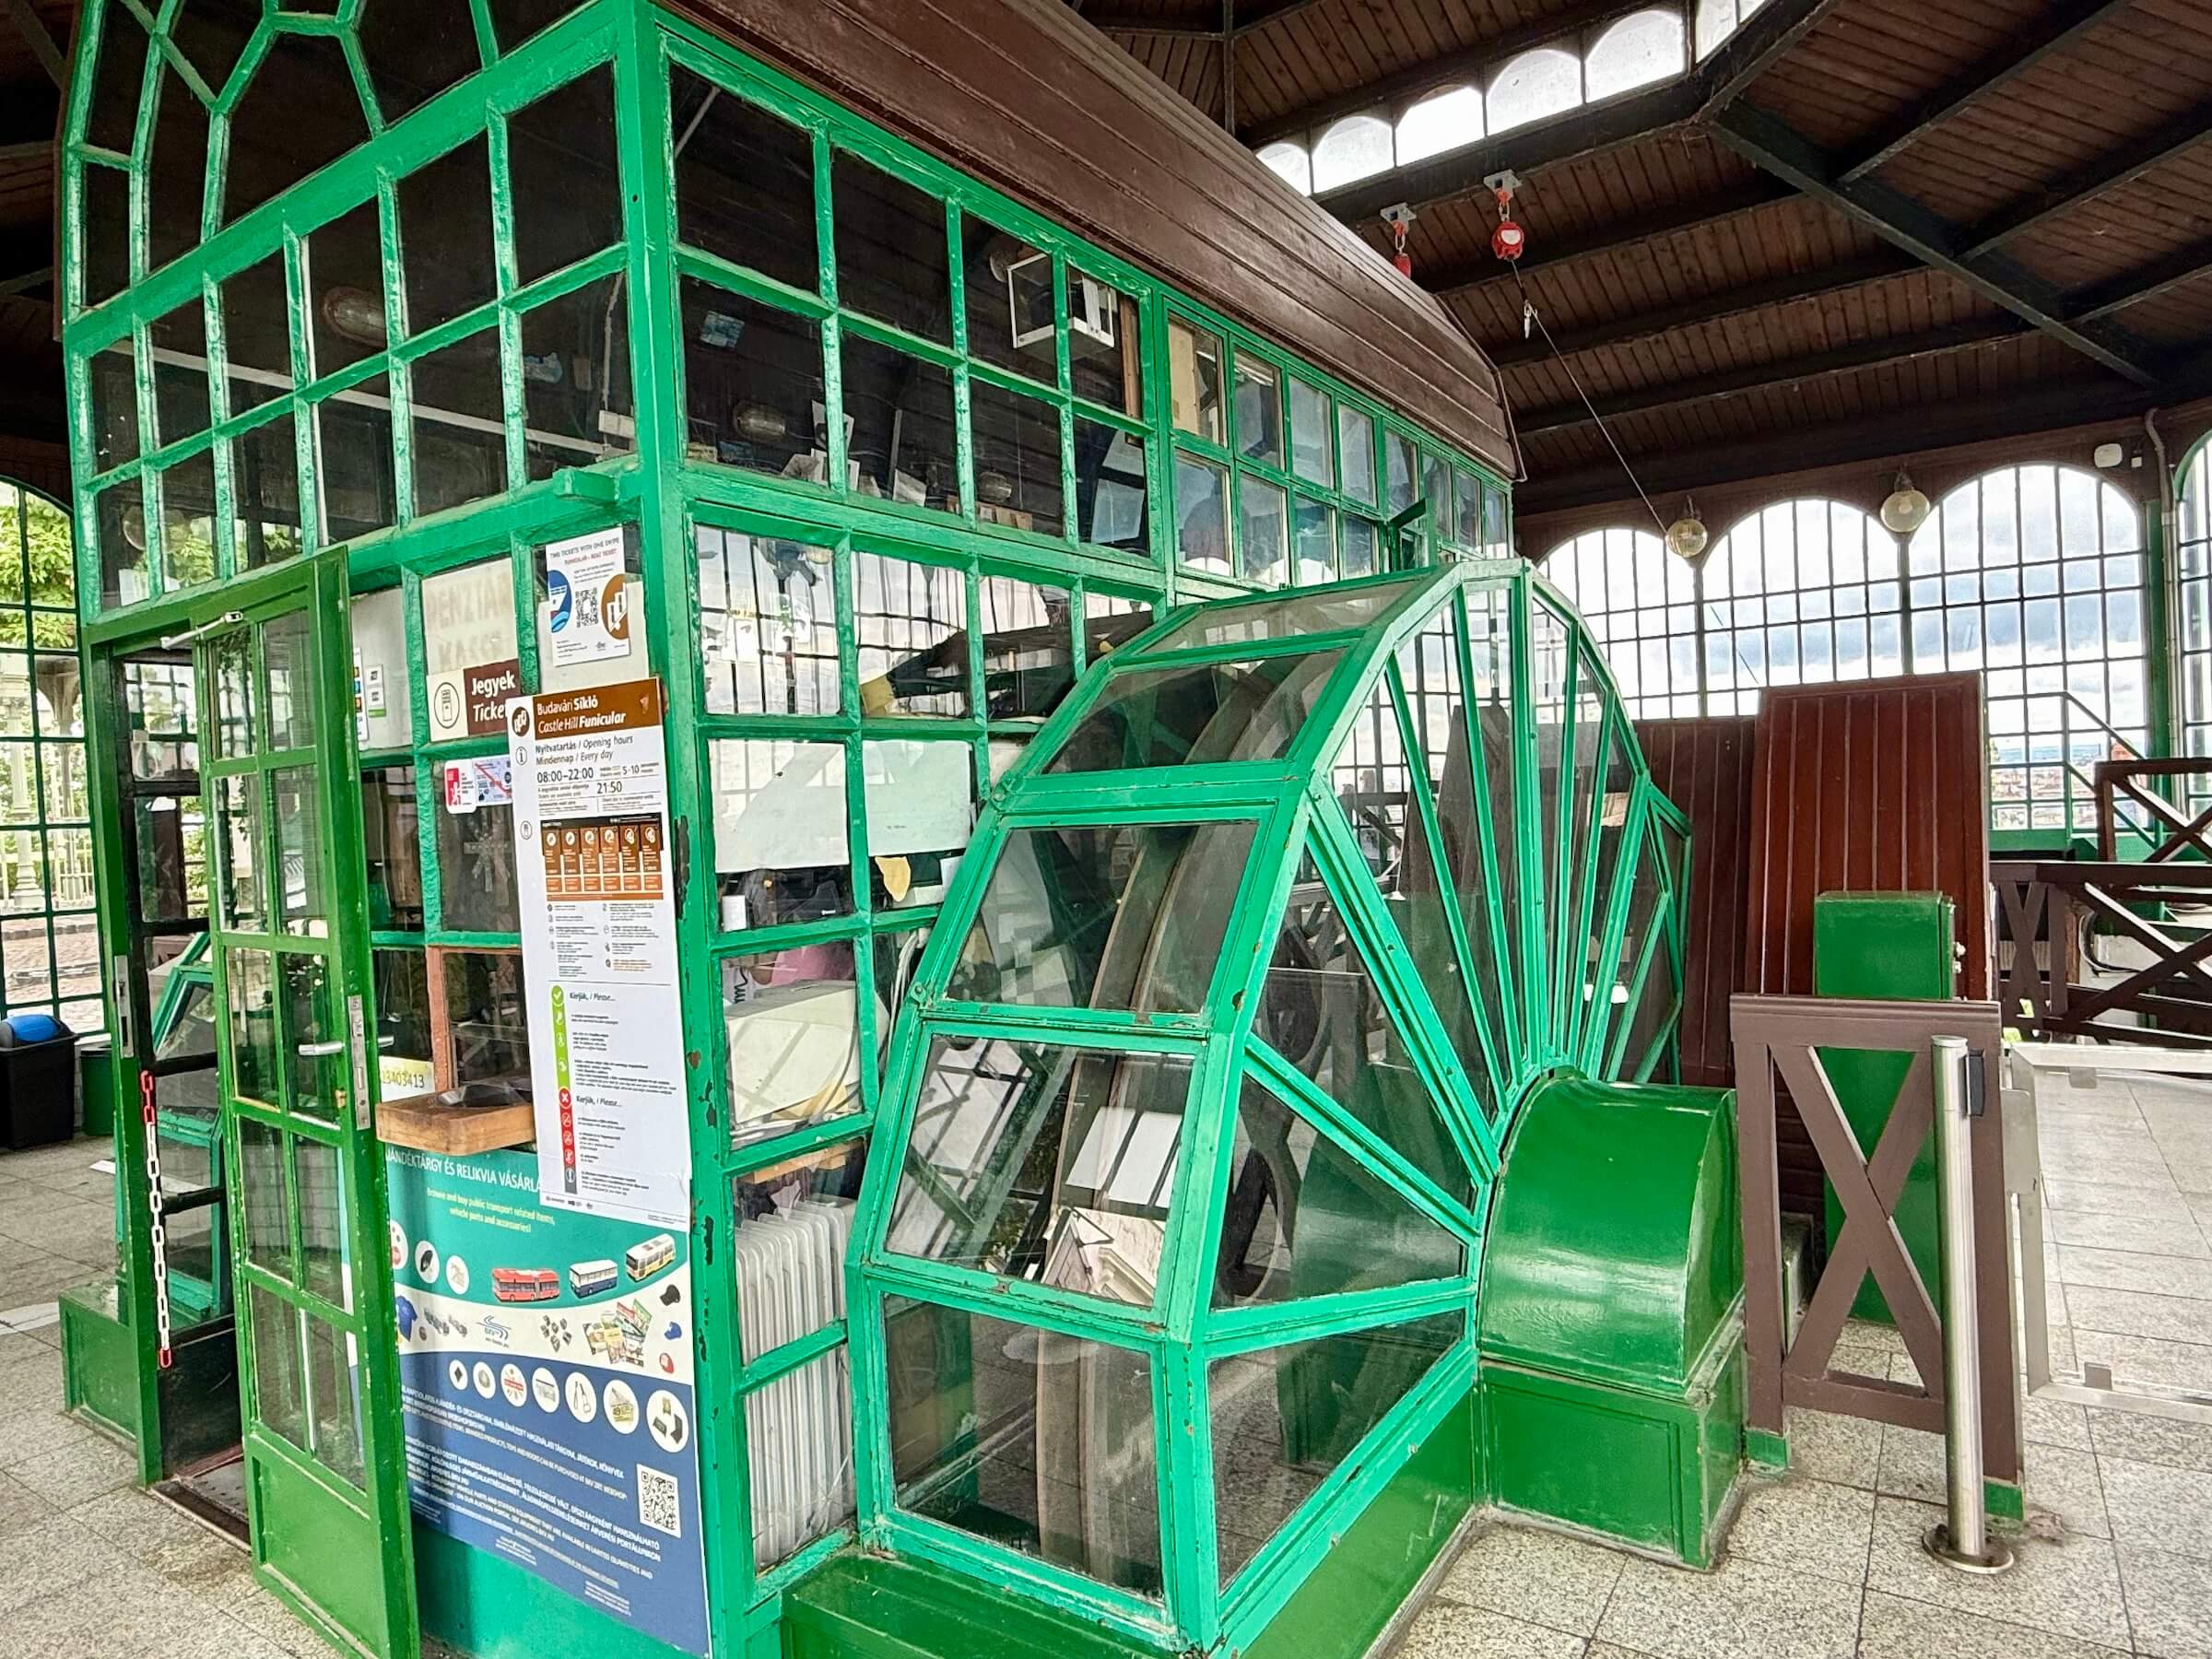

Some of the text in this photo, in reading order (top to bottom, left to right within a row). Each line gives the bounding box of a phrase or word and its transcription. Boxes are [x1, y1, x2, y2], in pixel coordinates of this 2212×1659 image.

[560, 547, 580, 558] TICKETS
[580, 543, 592, 553] WITH
[471, 670, 516, 699] Jegyek
[472, 700, 505, 723] Ticke
[536, 694, 598, 716] Budavári Sikló
[537, 711, 627, 734] Castle Hill Funicular
[535, 741, 577, 755] Nyitvatartás
[582, 737, 611, 749] Opening
[613, 735, 633, 746] hours
[535, 754, 574, 766] Mindennap
[581, 751, 599, 762] Every
[600, 749, 614, 760] day
[596, 781, 623, 794] 21:50
[385, 1147, 539, 1193] JÁNDÉKTÁRGY ÉS RELIKVIA VÁSÁRL
[446, 1190, 458, 1202] and
[457, 1192, 470, 1206] buy
[469, 1196, 486, 1210] public
[486, 1201, 513, 1217] transport
[469, 1212, 484, 1224] parts
[485, 1213, 496, 1224] and
